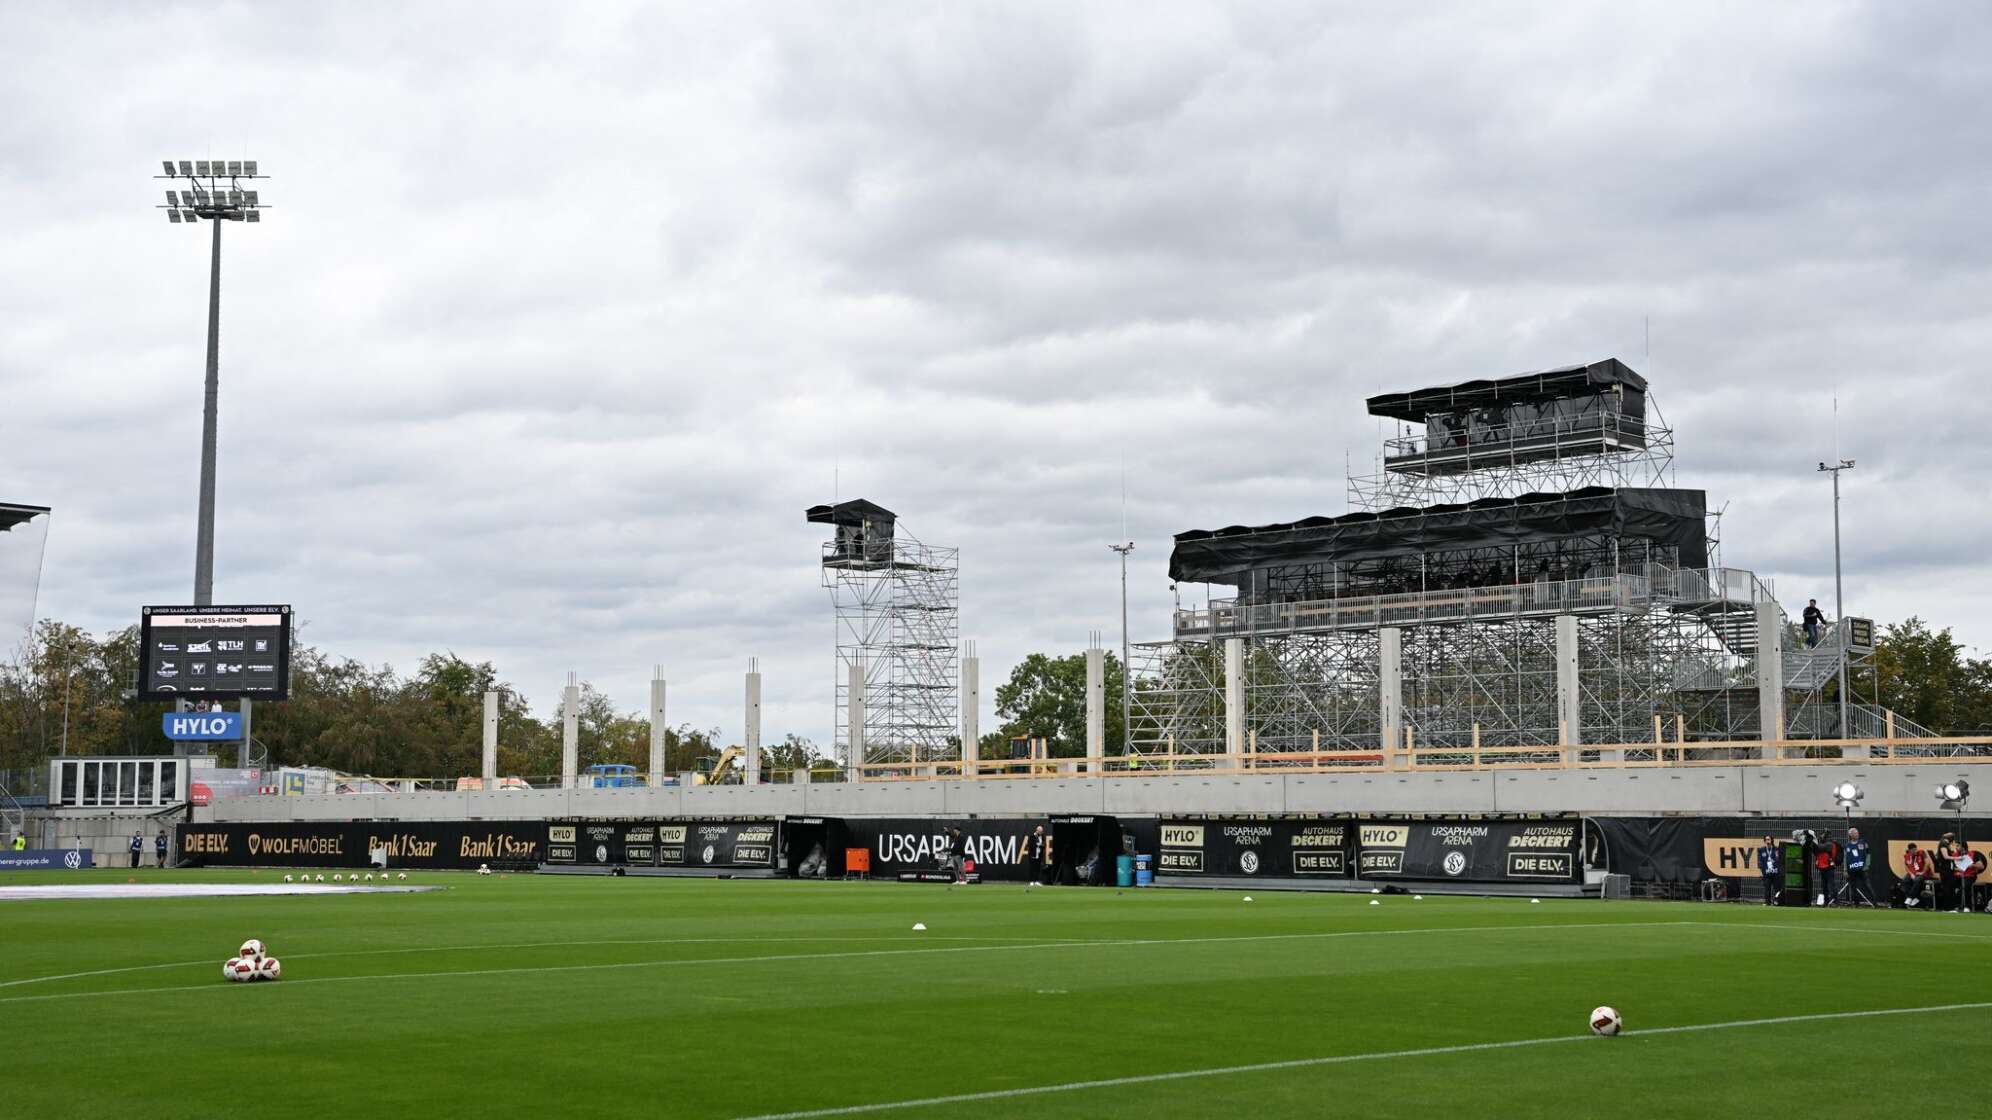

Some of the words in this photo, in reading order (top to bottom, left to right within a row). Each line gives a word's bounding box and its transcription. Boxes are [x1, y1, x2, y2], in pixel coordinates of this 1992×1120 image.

[173, 718, 227, 735] HYLO
[553, 830, 571, 839] HYLO
[662, 830, 681, 840] HYLO
[1165, 830, 1195, 842] HYLO
[1223, 827, 1272, 836] URSAPHARM
[1302, 827, 1344, 835] AUTOHAUS
[1363, 830, 1398, 842] HYLO
[1431, 827, 1488, 837] URSAPHARM
[1523, 827, 1574, 836] AUTOHAUS
[185, 833, 205, 852] DIE
[737, 833, 773, 842] DECKERT
[1235, 835, 1261, 845] ARENA
[1291, 835, 1344, 846] DECKERT
[1442, 836, 1473, 846] ARENA
[1507, 835, 1573, 847] DECKERT
[262, 836, 343, 854] WOLFMÖBEL
[737, 848, 750, 858] DIE
[1719, 846, 1761, 869] HY
[1161, 854, 1178, 865] DIE
[1299, 857, 1318, 868] DIE
[1362, 856, 1376, 868] DIE
[1515, 858, 1537, 870] DIE
